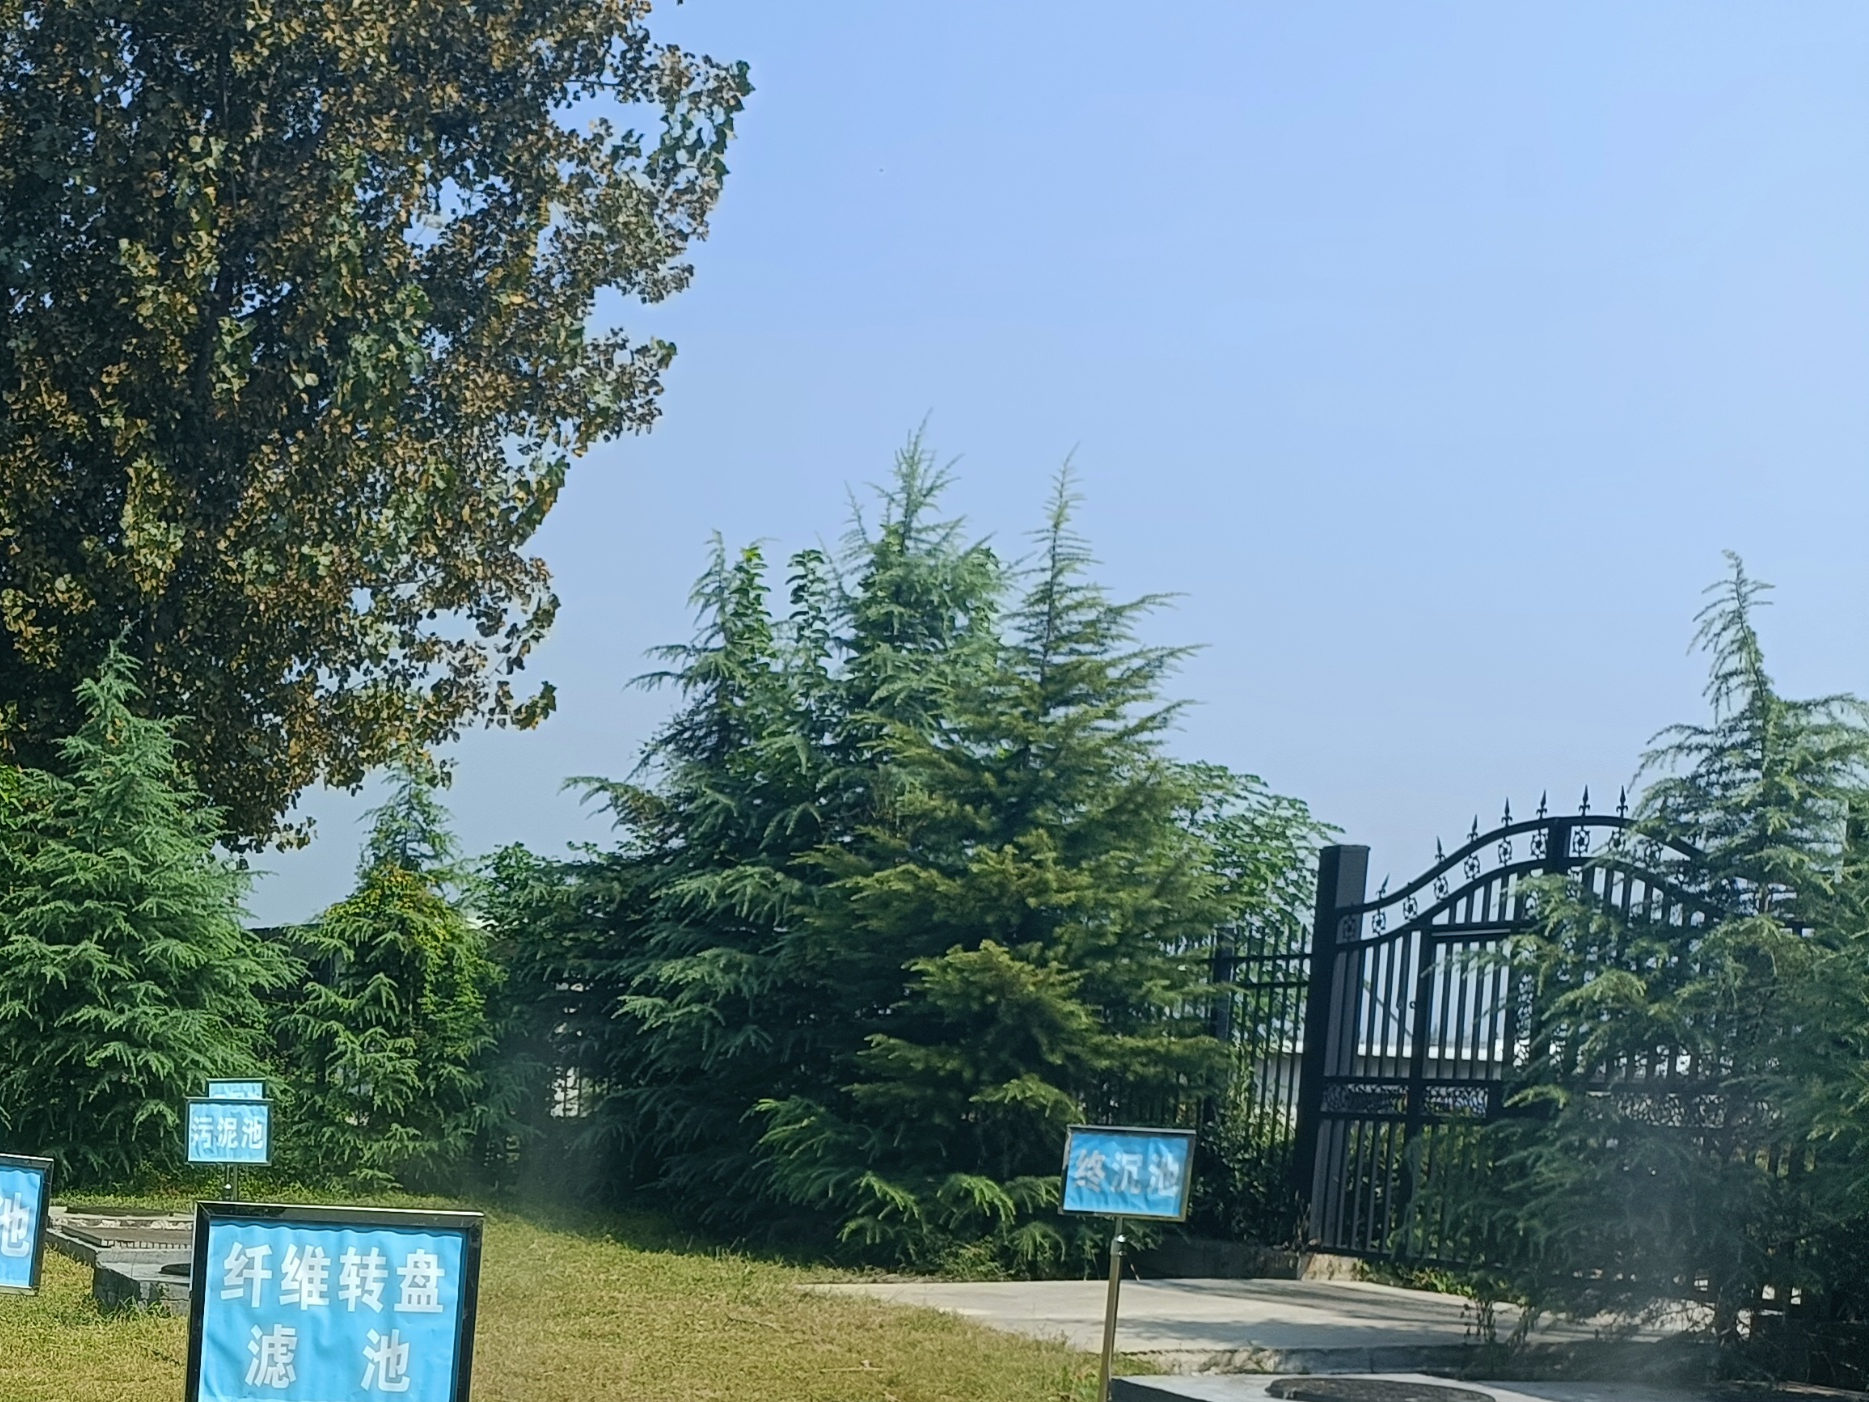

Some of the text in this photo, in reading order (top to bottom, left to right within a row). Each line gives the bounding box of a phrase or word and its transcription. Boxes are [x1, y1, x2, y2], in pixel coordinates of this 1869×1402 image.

[191, 1116, 264, 1149] 污泥池
[220, 1241, 446, 1314] 纤维转盘
